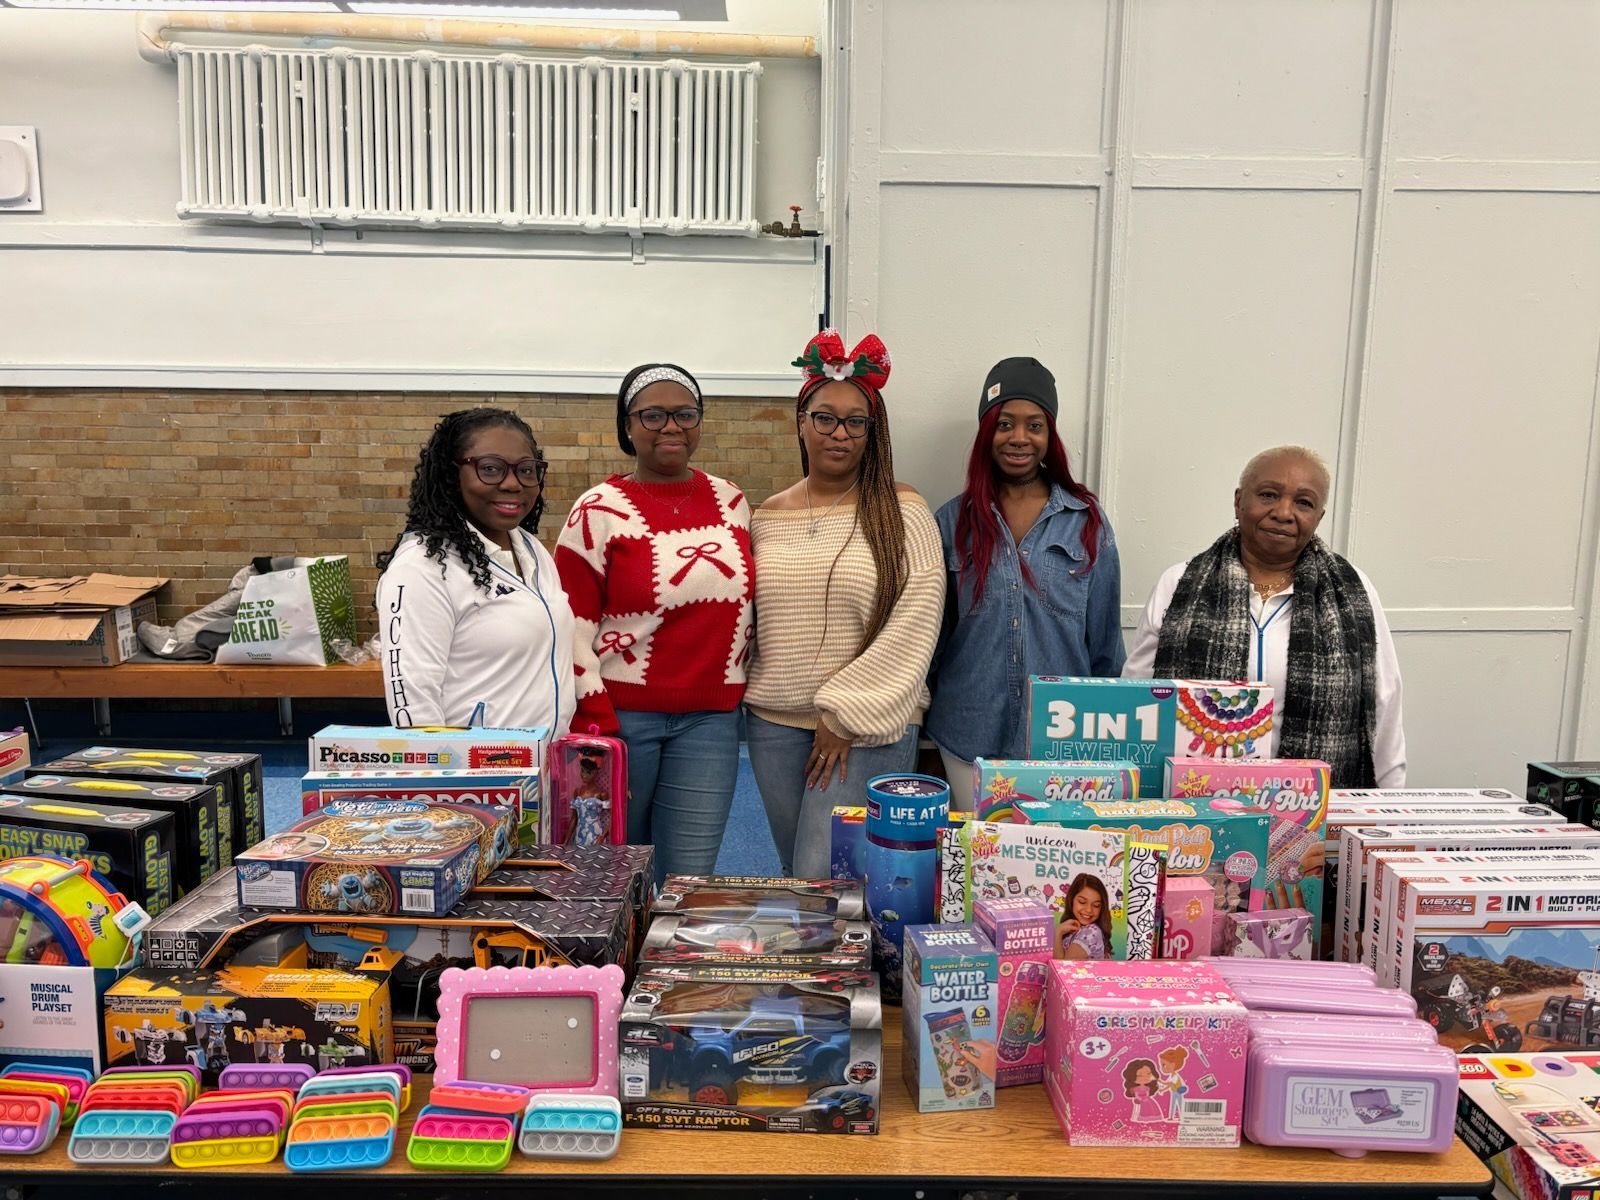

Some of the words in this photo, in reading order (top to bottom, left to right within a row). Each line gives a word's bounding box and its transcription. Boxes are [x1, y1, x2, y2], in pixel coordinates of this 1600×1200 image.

[239, 601, 255, 610] ME
[256, 599, 275, 609] TO
[237, 609, 272, 620] REAK
[231, 618, 280, 644] BREAD
[1046, 700, 1076, 739] 3
[1082, 712, 1128, 741] IN
[1135, 703, 1160, 741] 1
[1045, 741, 1156, 764] JEWELRY
[1049, 775, 1117, 783] COLOR-CHANGING
[1231, 776, 1258, 789] ALL
[1262, 777, 1315, 790] ABOUT
[992, 789, 1016, 800] Style
[1044, 784, 1113, 800] Mood
[1274, 789, 1321, 812] Art
[890, 806, 916, 820] LIFE
[920, 806, 937, 820] AT
[1257, 818, 1269, 826] 6+
[199, 807, 209, 856] GLOW
[1, 828, 39, 845] EASY
[42, 833, 86, 850] SNAP
[1025, 835, 1077, 849] unicorn
[145, 835, 158, 889] GLOW
[1001, 844, 1108, 867] MESSENGER
[1168, 851, 1203, 869] lon
[1035, 863, 1070, 879] BAG
[1421, 898, 1473, 906] METAL
[1486, 896, 1503, 912] 2
[1507, 895, 1531, 912] IN
[1535, 896, 1544, 912] 1
[1006, 927, 1046, 939] WATER
[1373, 918, 1380, 935] IN
[923, 932, 972, 940] WATER
[1003, 937, 1048, 950] BOTTLE
[1396, 940, 1403, 957] IN
[1428, 945, 1440, 955] 2
[933, 970, 986, 987] WATER
[31, 983, 73, 993] MUSICAL
[930, 985, 989, 1002] BOTTLE
[31, 993, 60, 1002] DRUM
[32, 1002, 73, 1013] PLAYSET
[315, 1003, 361, 1021] FDJ
[975, 1005, 986, 1018] 6
[1142, 1016, 1203, 1029] MAKEUP
[395, 1042, 417, 1055] UTY
[1085, 1041, 1107, 1055] 3+
[396, 1055, 429, 1064] TRUCKS
[1460, 1064, 1484, 1072] EGO
[1301, 1086, 1345, 1107] GEM
[662, 1107, 696, 1115] ROAD
[1294, 1104, 1350, 1120] Stationery
[626, 1113, 661, 1122] F-150
[665, 1115, 691, 1124] SVT
[695, 1116, 750, 1126] RAPTOR
